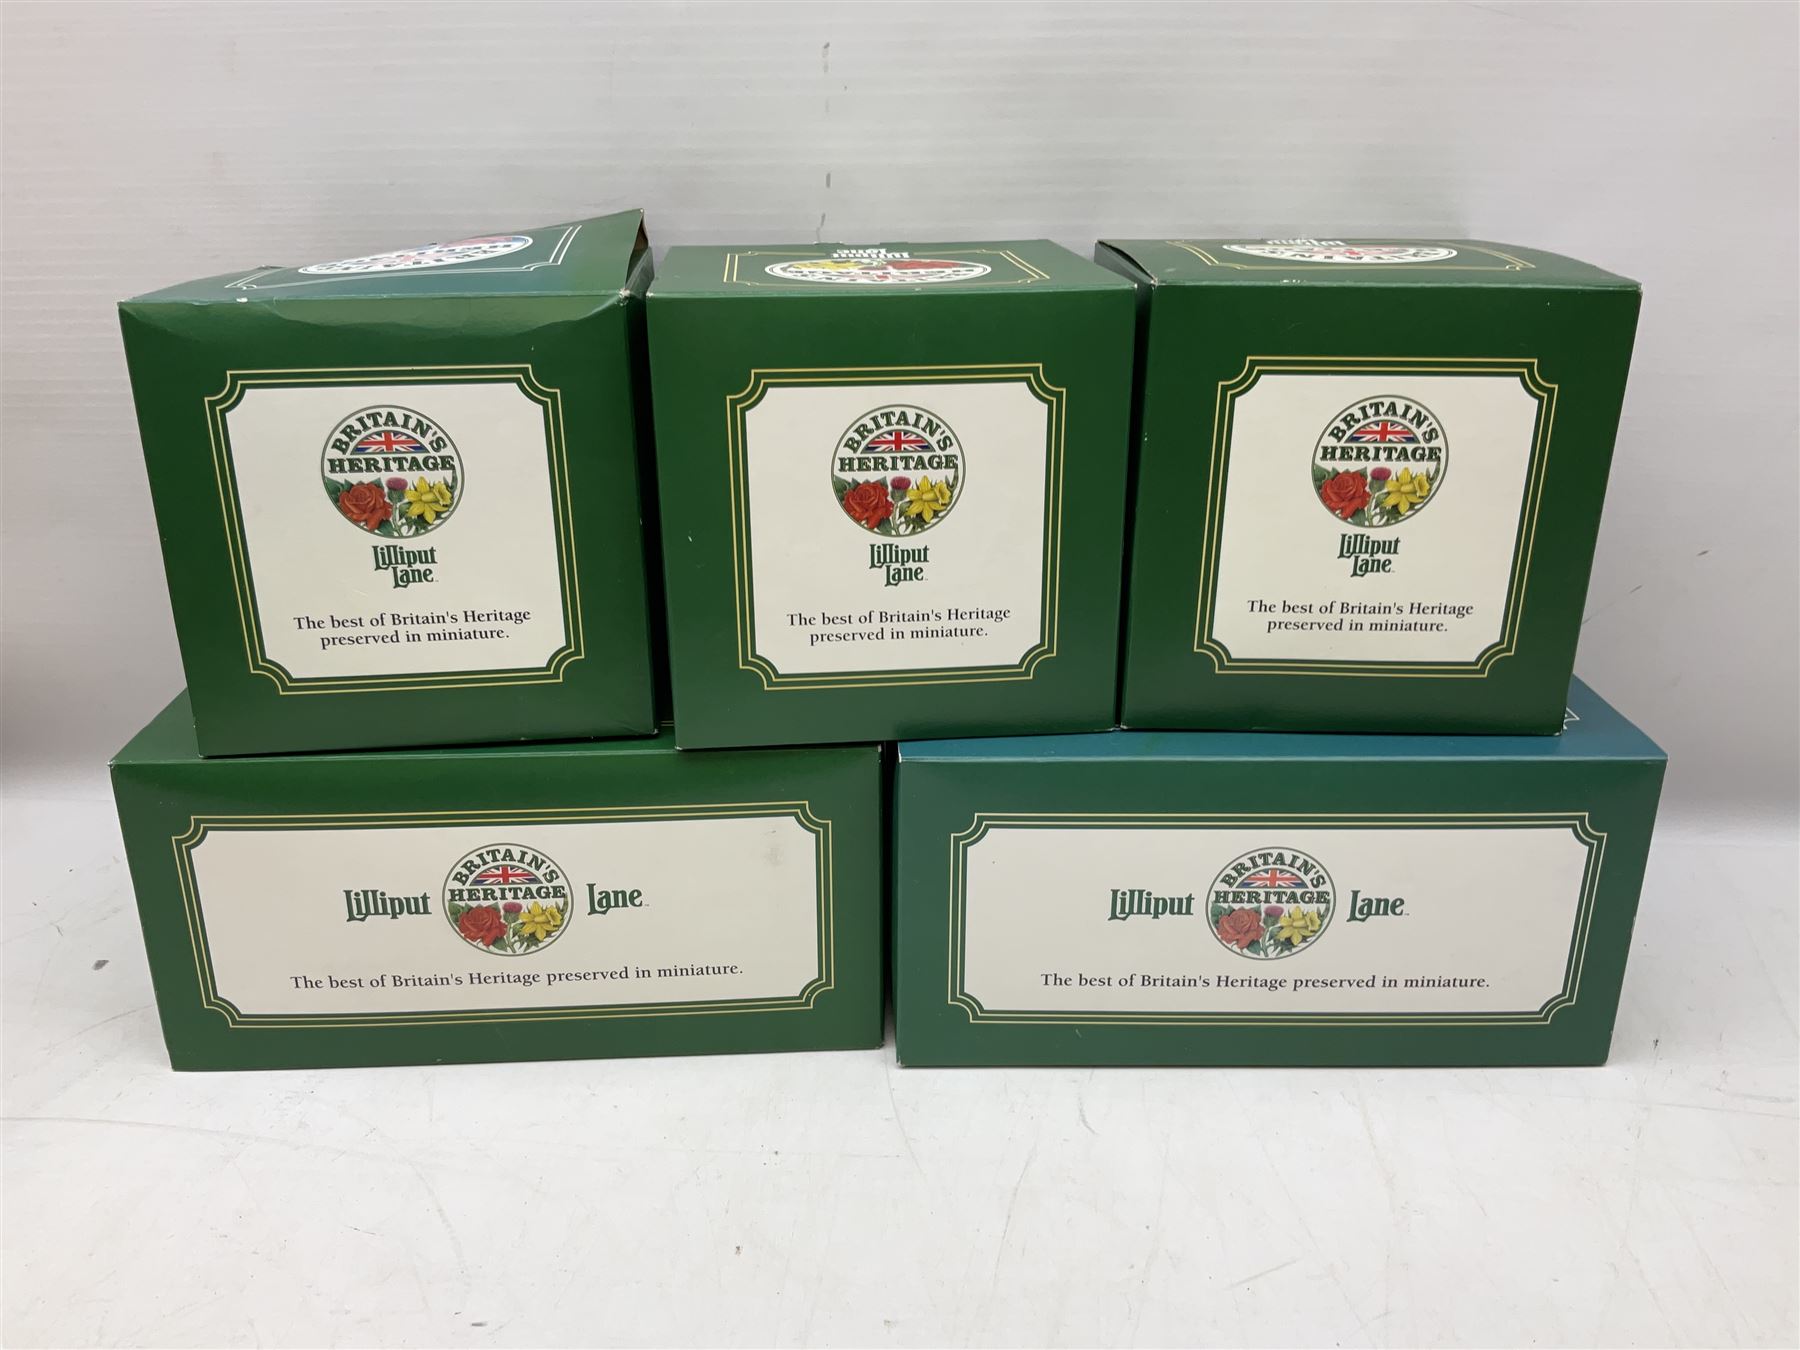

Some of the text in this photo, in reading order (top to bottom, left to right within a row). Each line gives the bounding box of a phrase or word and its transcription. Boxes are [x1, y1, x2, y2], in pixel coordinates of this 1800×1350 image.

[331, 411, 448, 455] BRITAIN'S
[843, 410, 953, 453] BRITAIN'S
[1328, 401, 1440, 444] BRITAIN'S
[327, 455, 456, 474] HERITAGE
[838, 454, 958, 472] HERITAGE
[1320, 446, 1442, 462] HERITAGE
[869, 543, 929, 569] Lilliput
[1337, 533, 1401, 559] Lilliput
[372, 545, 437, 571] Lilliput
[1350, 555, 1392, 577] Lane
[392, 566, 434, 589] Lane
[885, 565, 924, 587] Lane
[292, 609, 531, 630] The best of Britain's Heritage
[786, 607, 1011, 626] The best of Britain's Heritage
[1247, 599, 1474, 619] The best of Britain's Heritage
[810, 625, 988, 647] preserved in miniature.
[1266, 617, 1448, 634] preserved in miniature.
[319, 625, 511, 651] preserved in miniature.
[452, 847, 560, 886] BRITAIN'S
[1220, 852, 1326, 889] BRITAIN'S
[343, 883, 643, 922] Lilliput Lane
[448, 884, 566, 902] HERITAGE
[1213, 889, 1330, 905] HERITAGE
[1107, 888, 1405, 923] Lilliput Lane
[289, 963, 743, 989] The best of Britain's Heritage preserved in miniature.
[1040, 972, 1490, 992] The best of Britain's Heritage preserved in miniature.
